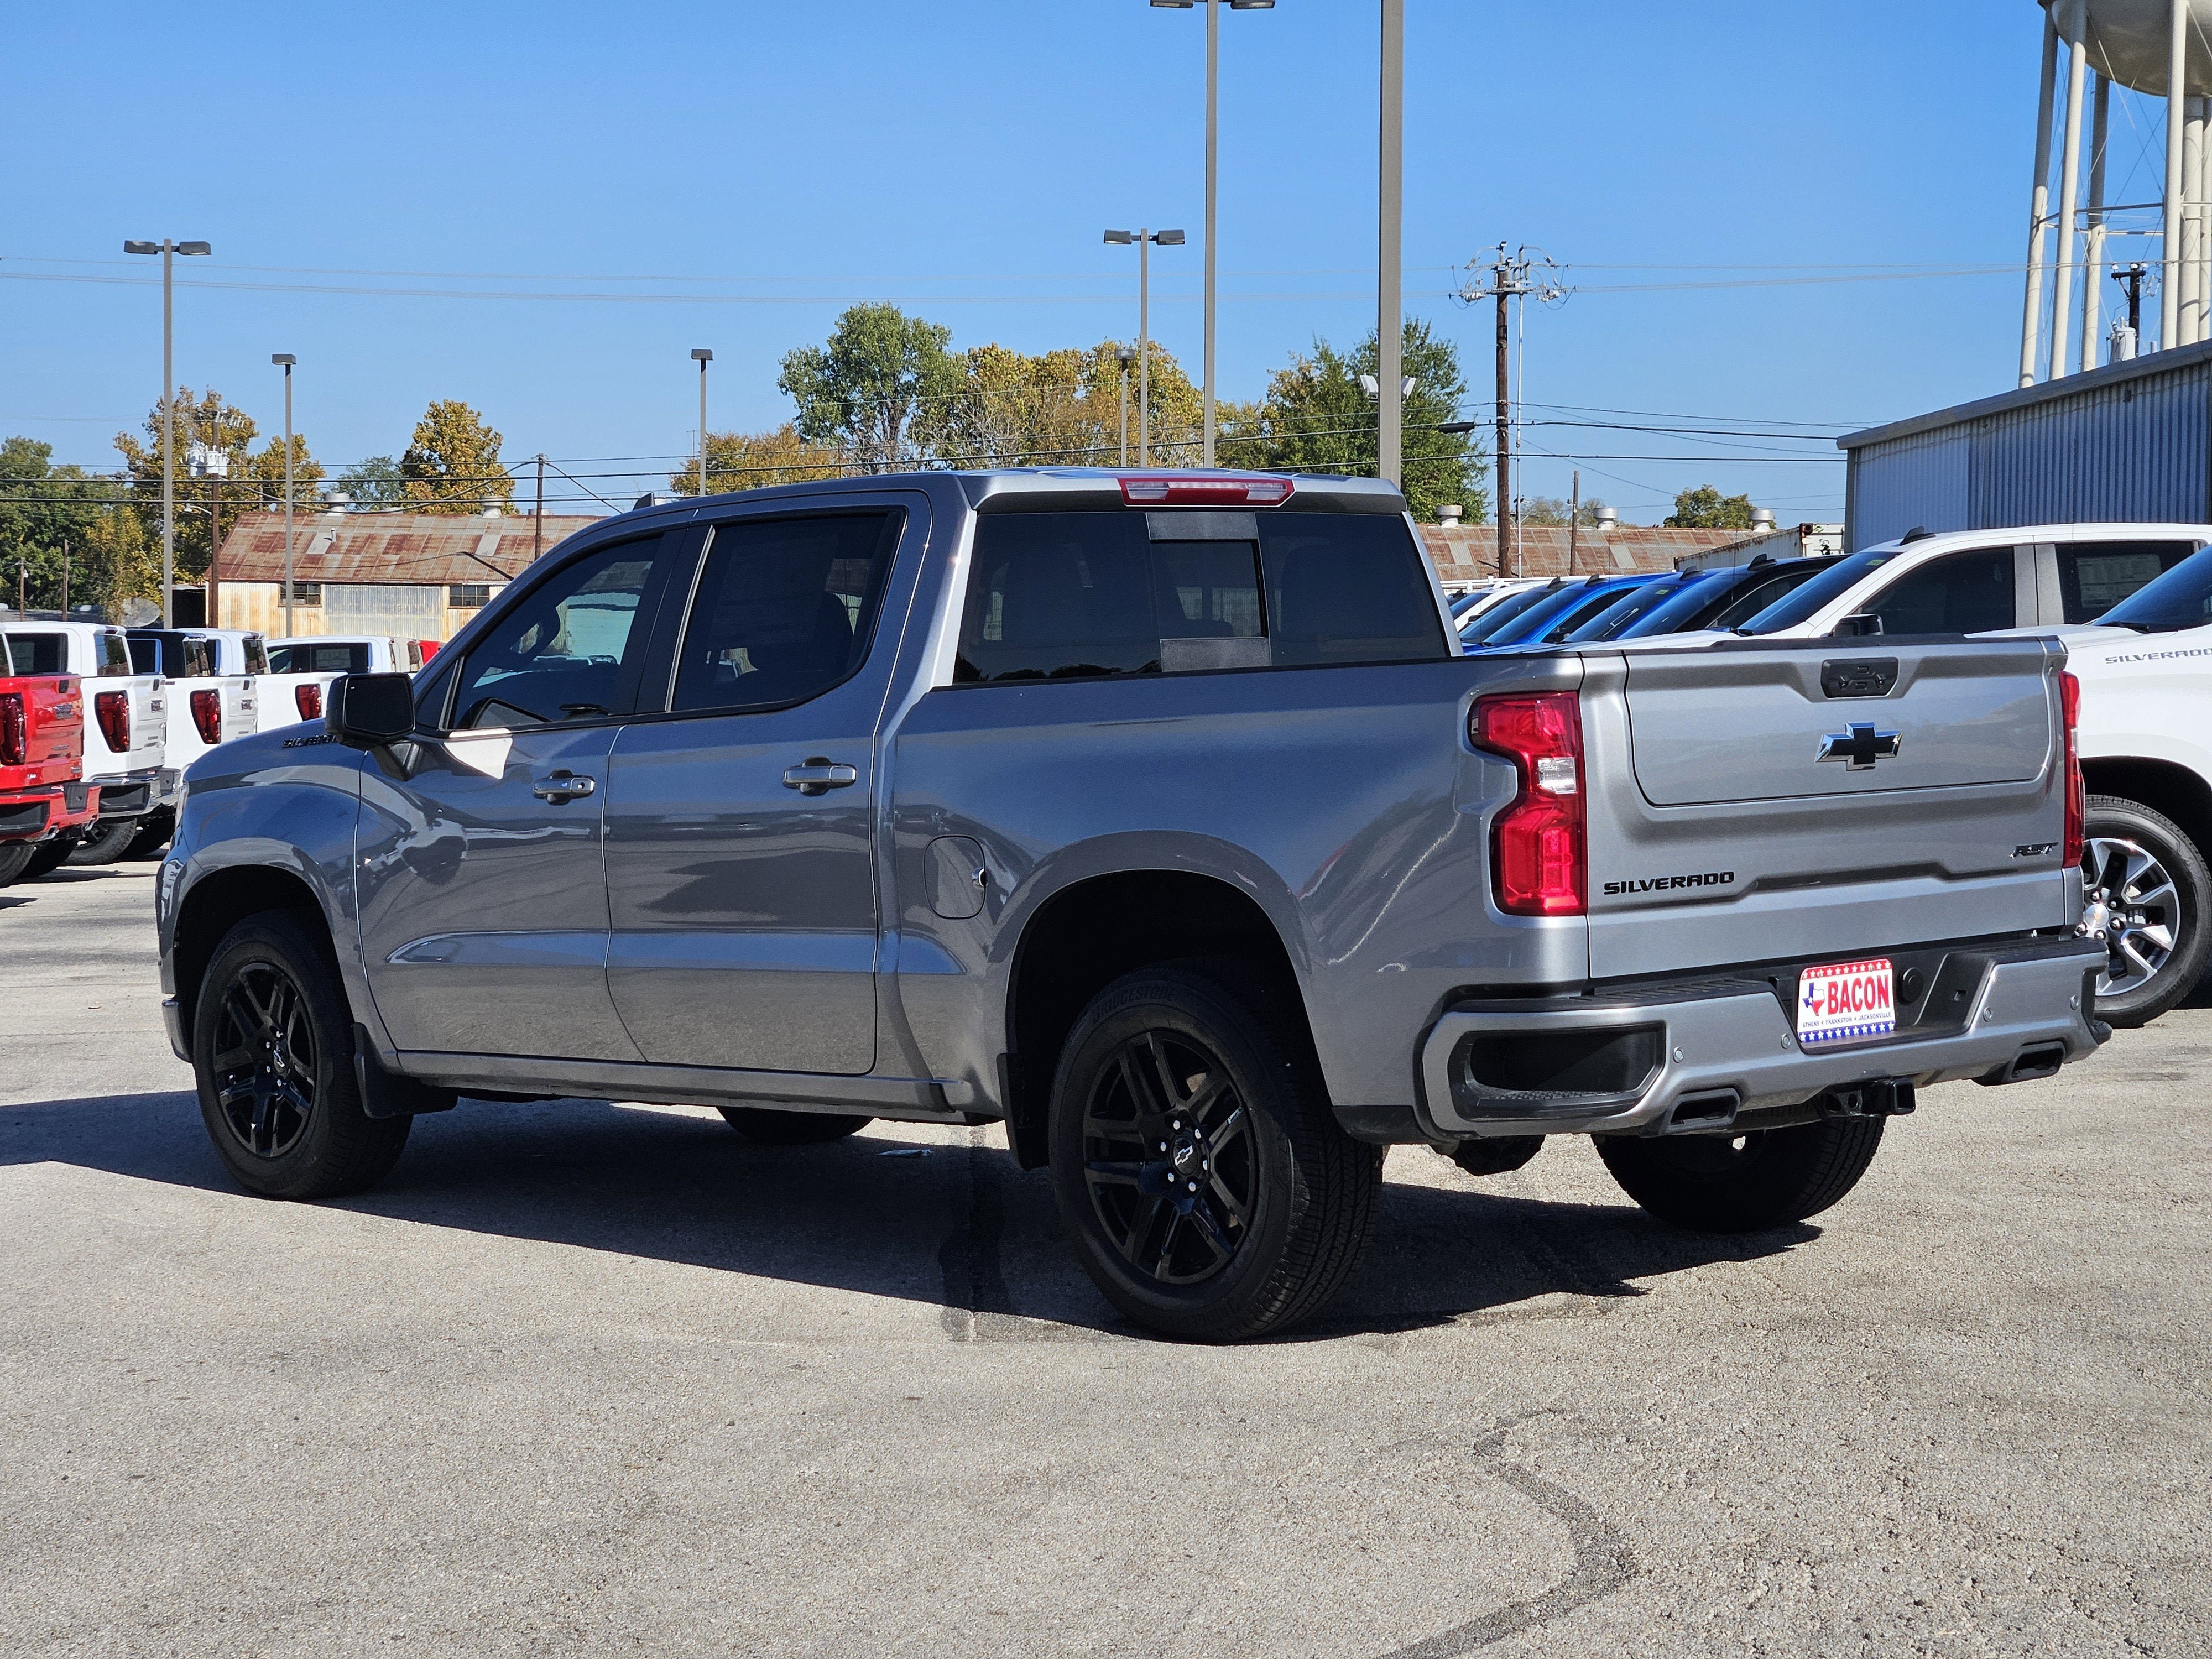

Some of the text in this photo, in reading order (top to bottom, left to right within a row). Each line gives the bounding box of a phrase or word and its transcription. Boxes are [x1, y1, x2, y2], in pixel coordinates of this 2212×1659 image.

[2105, 648, 2212, 664] SILVERADO
[1604, 871, 1735, 895] SILVERADO
[1828, 974, 1890, 1015] BACON
[1825, 1016, 1853, 1025] FRANKSTON
[1859, 1011, 1892, 1021] JACKSONVILLE
